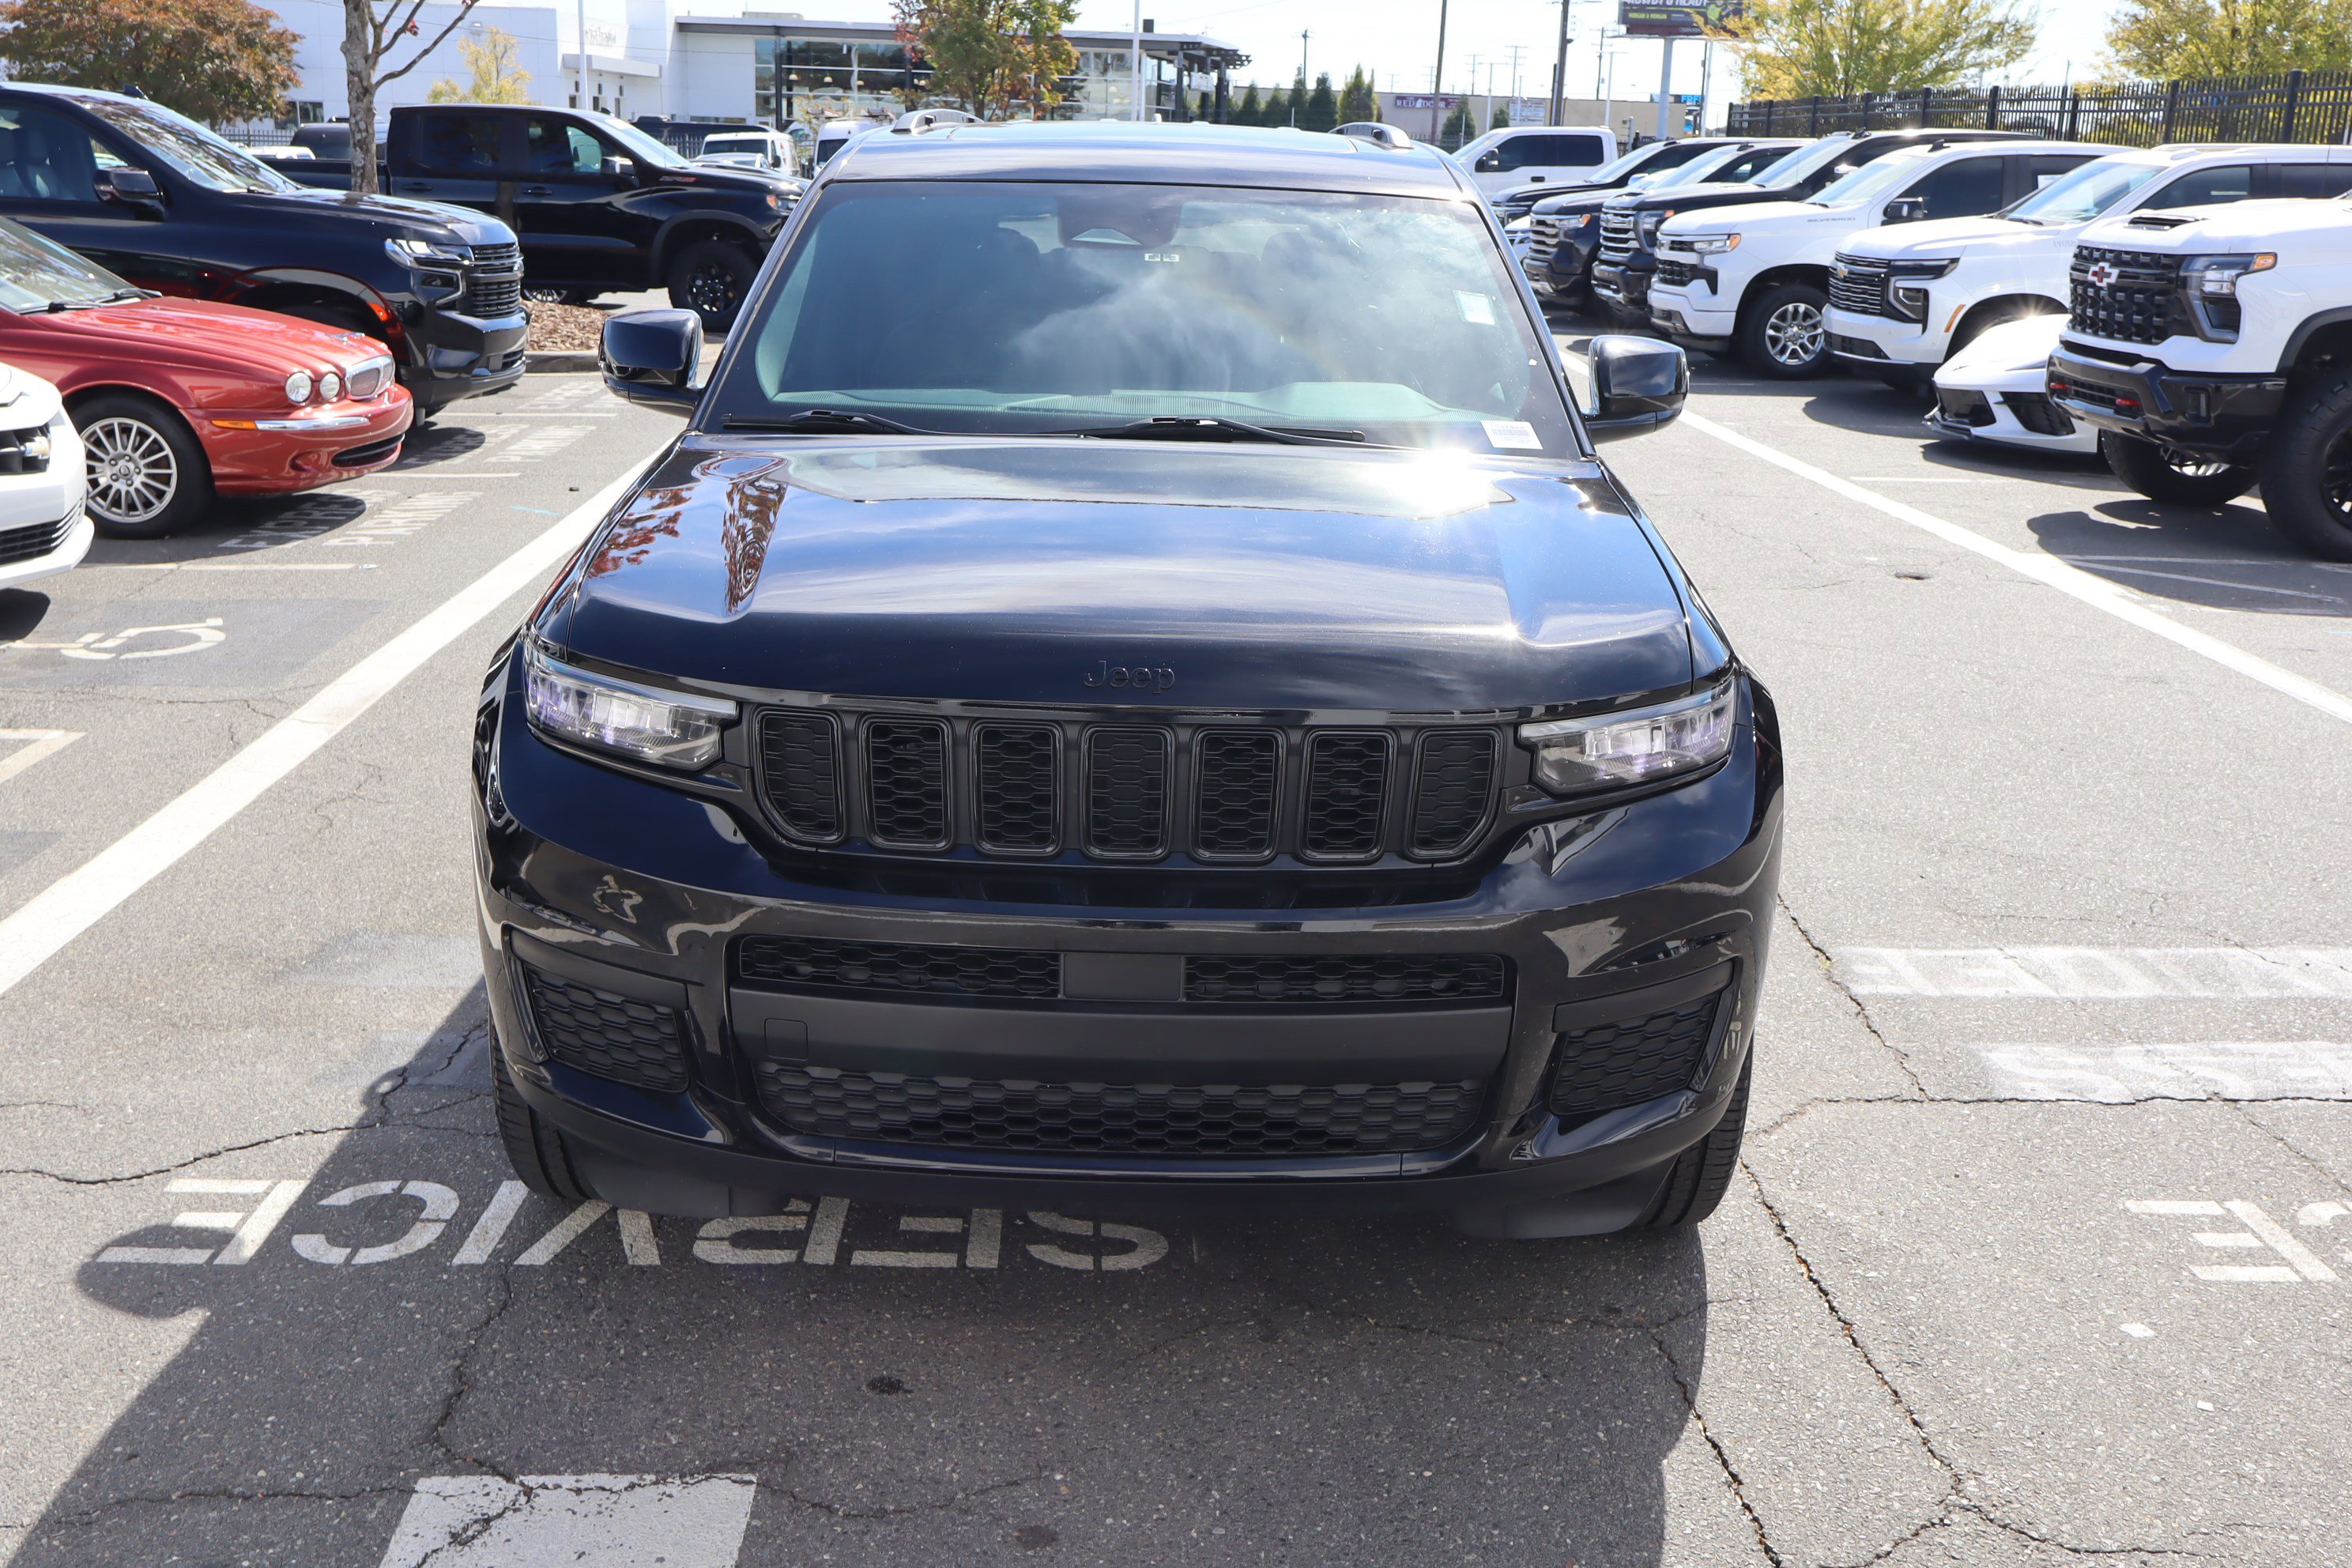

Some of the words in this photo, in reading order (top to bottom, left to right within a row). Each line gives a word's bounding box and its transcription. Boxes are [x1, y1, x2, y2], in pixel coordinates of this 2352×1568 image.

[1396, 99, 1415, 107] RED
[483, 424, 598, 463] PARKING
[322, 492, 484, 546] PARKING
[1083, 660, 1176, 694] Jeep
